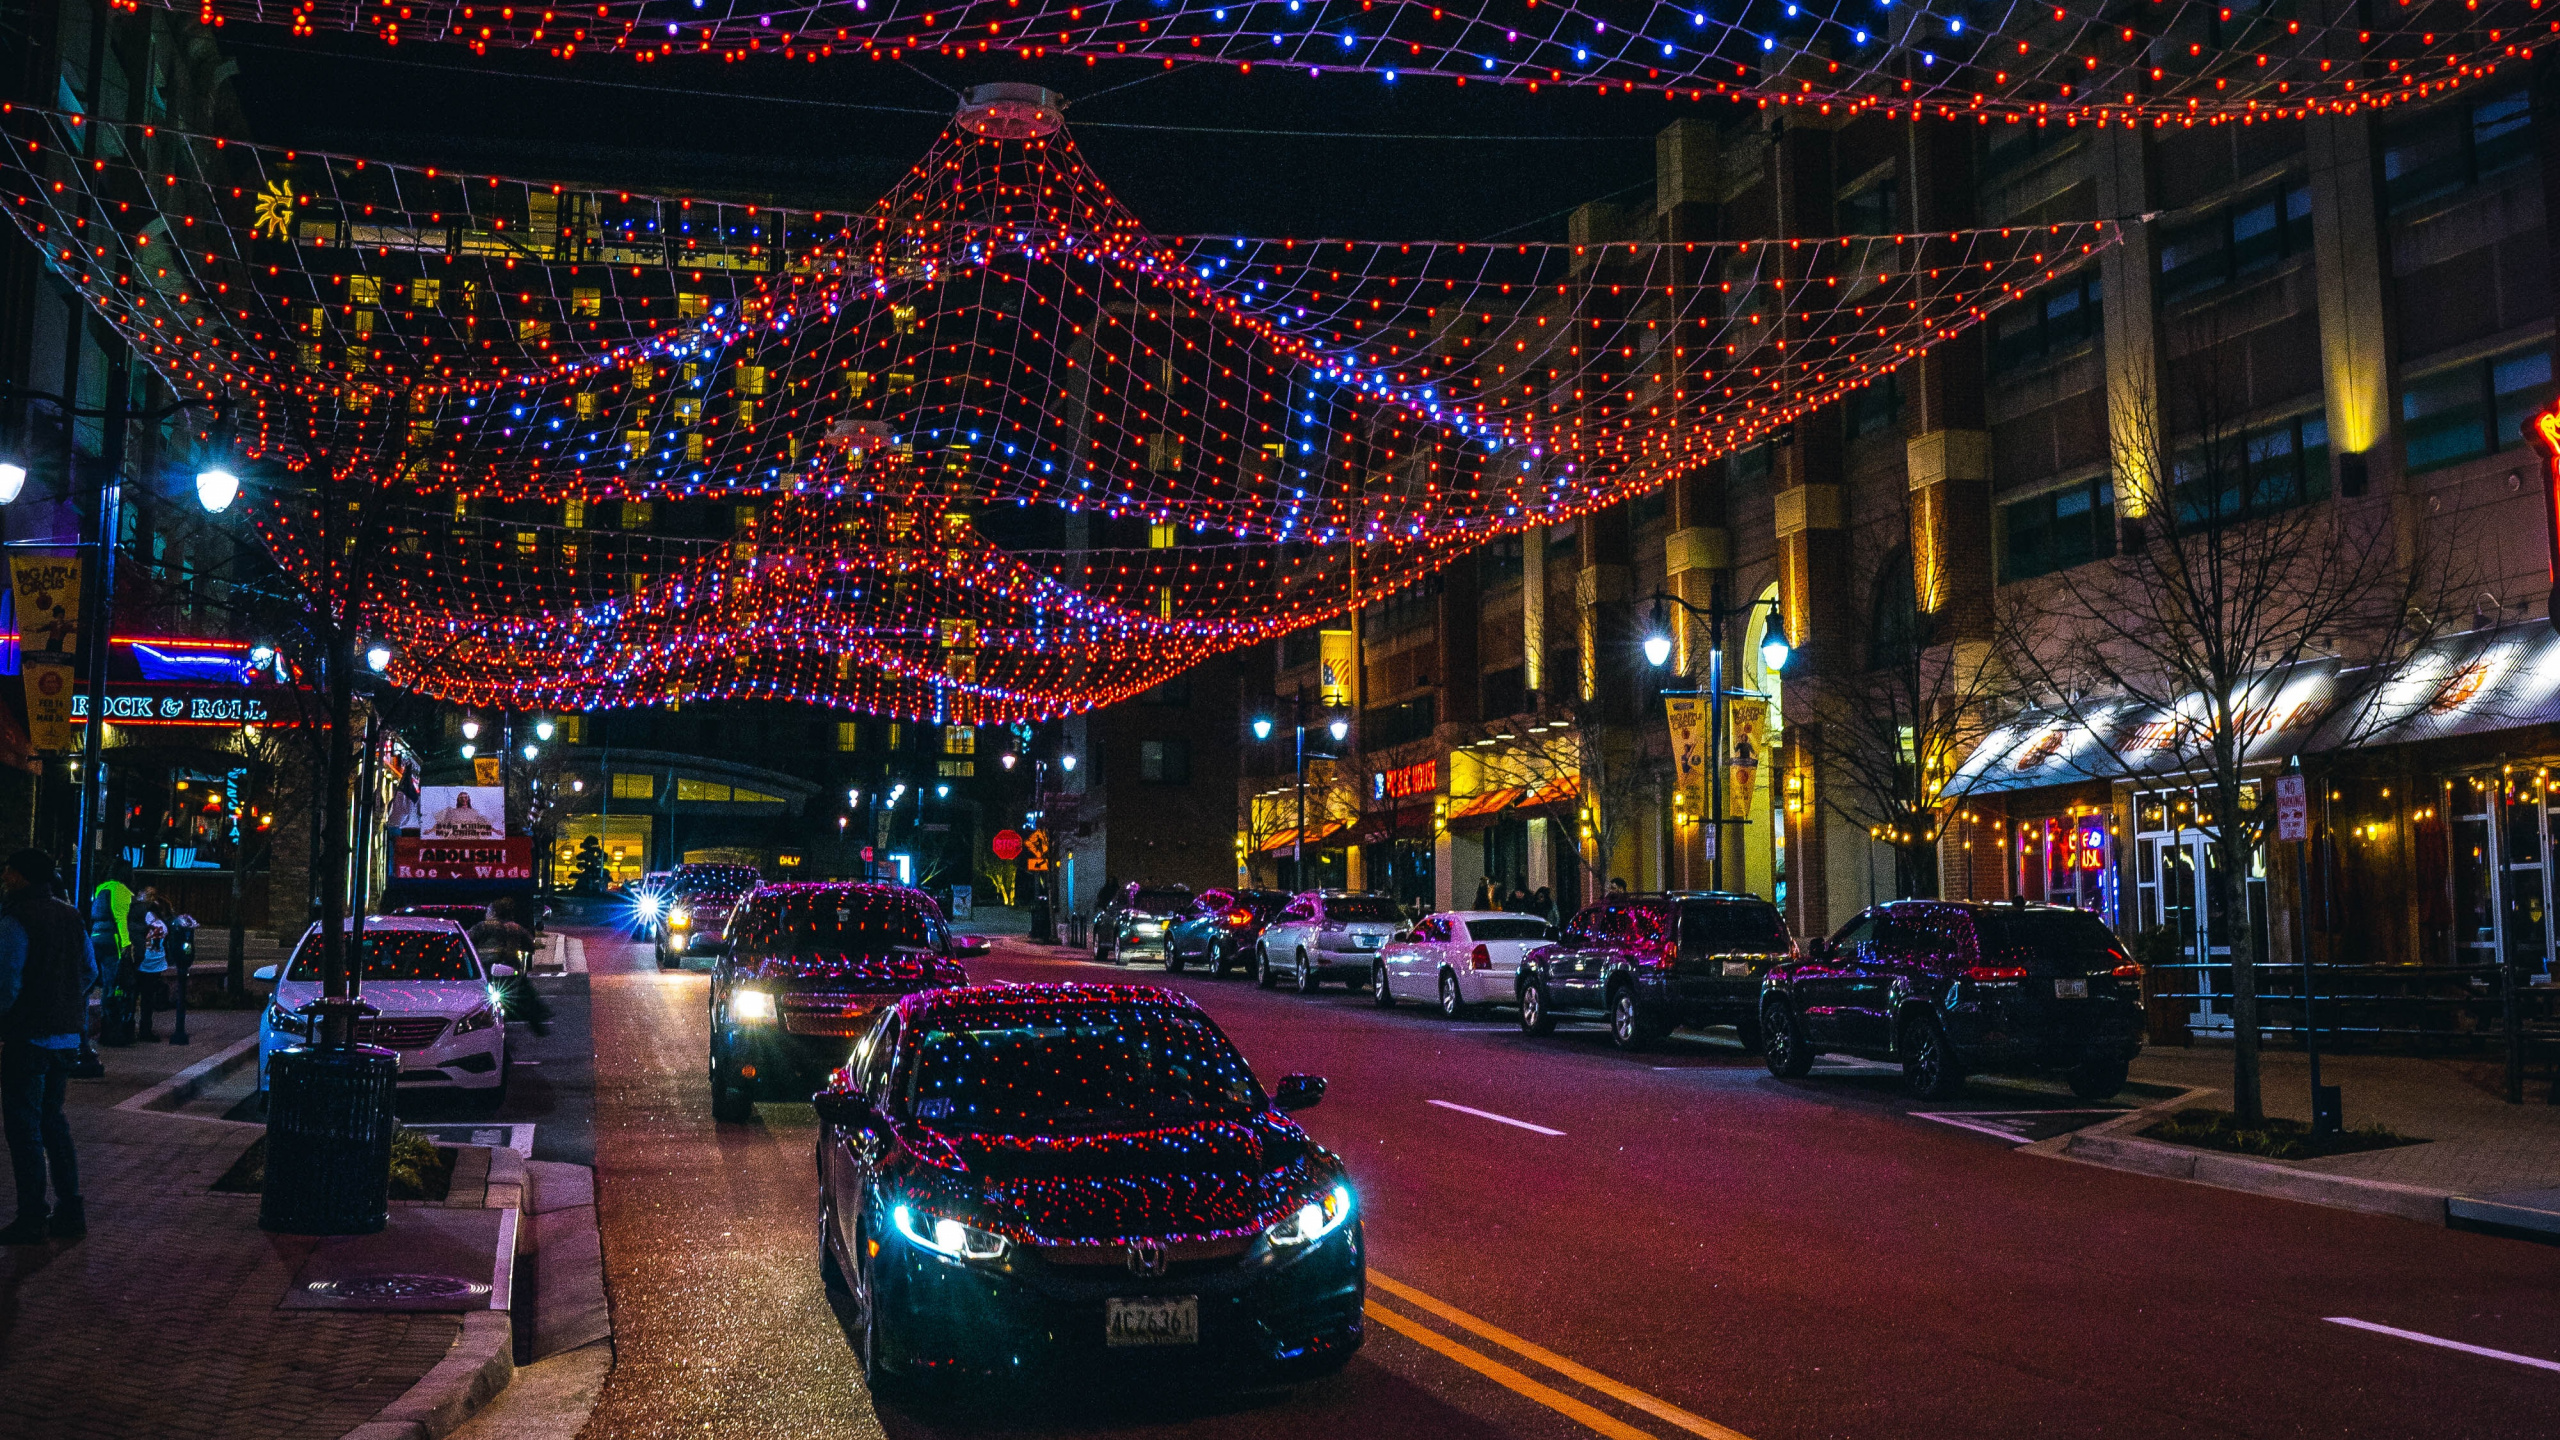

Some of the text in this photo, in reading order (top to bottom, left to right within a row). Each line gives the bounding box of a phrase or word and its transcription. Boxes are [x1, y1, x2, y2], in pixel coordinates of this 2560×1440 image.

[16, 566, 77, 583] BIG APPLE
[21, 577, 64, 595] CIRCUS
[160, 697, 184, 718] &
[191, 698, 268, 720] ROLL
[2284, 781, 2296, 795] NO
[2278, 796, 2304, 807] PARKING
[461, 823, 492, 831] Killing
[995, 838, 1019, 850] STOP
[422, 849, 502, 863] ABOLISH
[398, 866, 438, 878] Roe
[474, 866, 530, 878] Wade
